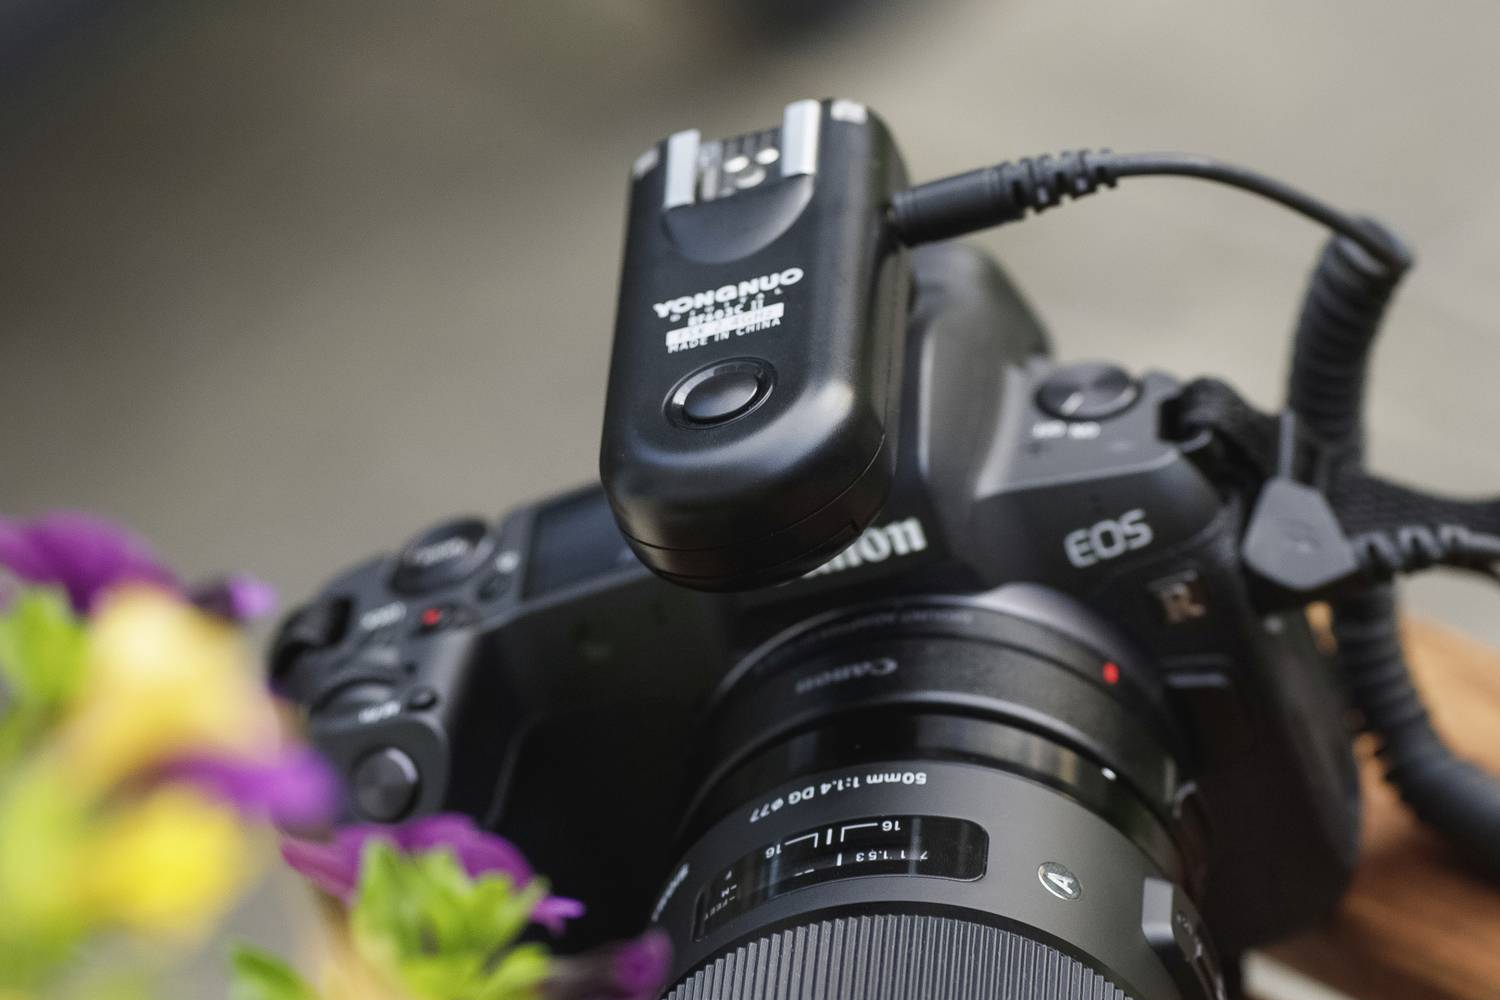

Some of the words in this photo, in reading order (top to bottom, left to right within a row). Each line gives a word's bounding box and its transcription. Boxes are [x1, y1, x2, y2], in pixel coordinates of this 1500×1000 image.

[653, 267, 804, 319] YONGNUO
[667, 336, 709, 354] MADE
[714, 330, 730, 342] IN
[736, 317, 782, 336] CHINA
[1063, 508, 1154, 568] EOS
[820, 776, 860, 796] 1:1.4
[866, 771, 928, 786] 50mm
[788, 786, 815, 805] DG
[882, 820, 901, 832] 16
[765, 843, 783, 859] 16
[856, 852, 865, 862] 3
[1047, 872, 1074, 895] A
